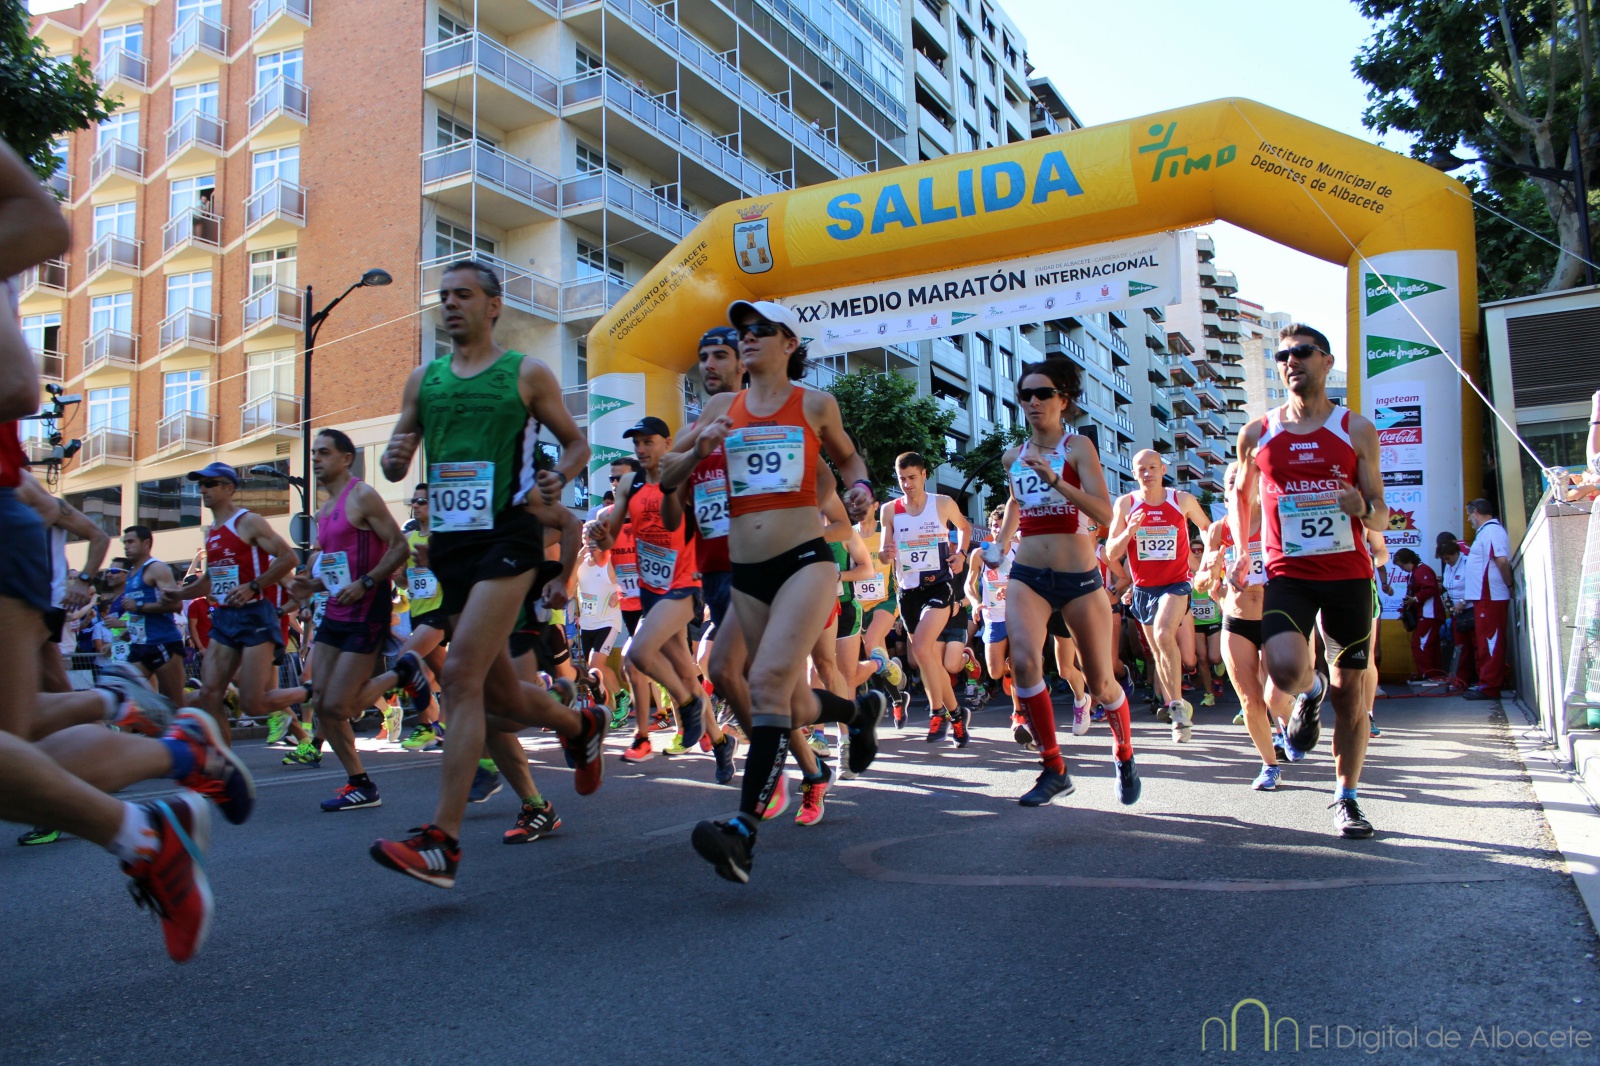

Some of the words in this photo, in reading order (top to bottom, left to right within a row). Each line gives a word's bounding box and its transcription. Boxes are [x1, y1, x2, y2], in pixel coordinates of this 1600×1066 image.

[1259, 141, 1313, 168] Instituto
[1316, 161, 1376, 191] Municipal
[1377, 185, 1392, 198] de
[1250, 154, 1307, 185] Deportes
[1310, 178, 1326, 192] de
[1328, 184, 1384, 214] Albacete
[826, 149, 1084, 241] SALIDA
[1034, 264, 1055, 273] CIUDAD
[1063, 258, 1091, 269] ALBACETE
[1093, 254, 1120, 263] CARRERA
[608, 286, 659, 337] AYUNTAMIENTO
[659, 277, 669, 288] DE
[670, 240, 708, 278] ALBACETE
[830, 291, 902, 319] MEDIO
[908, 268, 1027, 307] MARATÓN
[1034, 254, 1159, 288] INTERNACIONAL
[1396, 281, 1428, 297] Inglés
[617, 298, 660, 340] CONCEJALÍA
[660, 290, 670, 302] DE
[669, 253, 708, 292] DEPORTES
[1367, 350, 1375, 360] El
[1375, 349, 1396, 359] Corte
[1396, 344, 1429, 360] Inglés
[747, 451, 782, 475] 99
[431, 489, 488, 512] 1085
[1027, 504, 1077, 517] ALBACETE
[1301, 516, 1334, 539] 52
[1139, 539, 1175, 551] 1322
[910, 551, 928, 563] 87
[324, 571, 339, 585] 76
[414, 578, 427, 590] 89
[861, 583, 876, 593] 96
[1192, 607, 1211, 615] 238
[115, 644, 126, 655] 86
